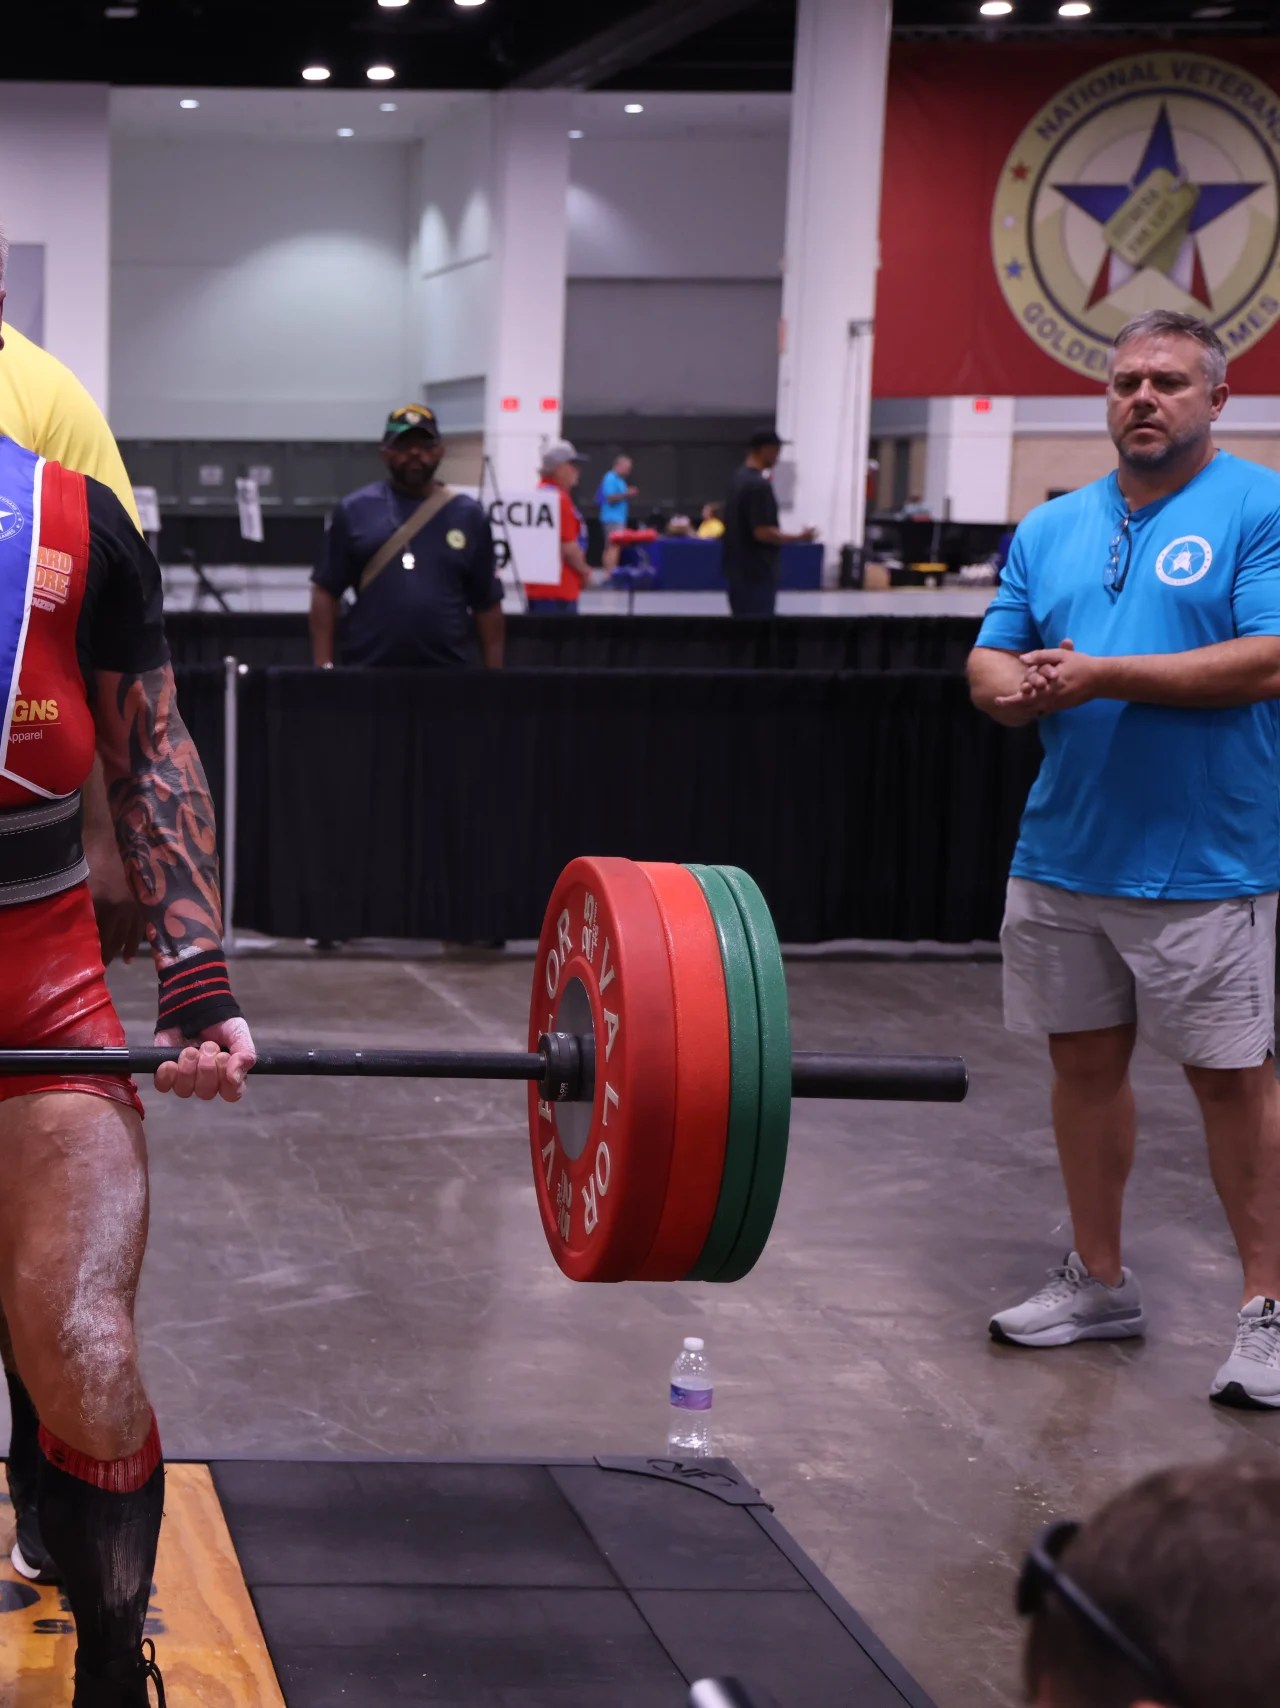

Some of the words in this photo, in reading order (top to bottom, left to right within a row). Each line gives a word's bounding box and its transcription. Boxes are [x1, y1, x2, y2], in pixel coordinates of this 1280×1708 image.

[1035, 60, 1161, 142] NATIONAL
[1023, 302, 1108, 371] GOLDE
[489, 501, 555, 528] CCIA
[13, 699, 59, 722] GNS
[581, 936, 620, 1236] VALOR
